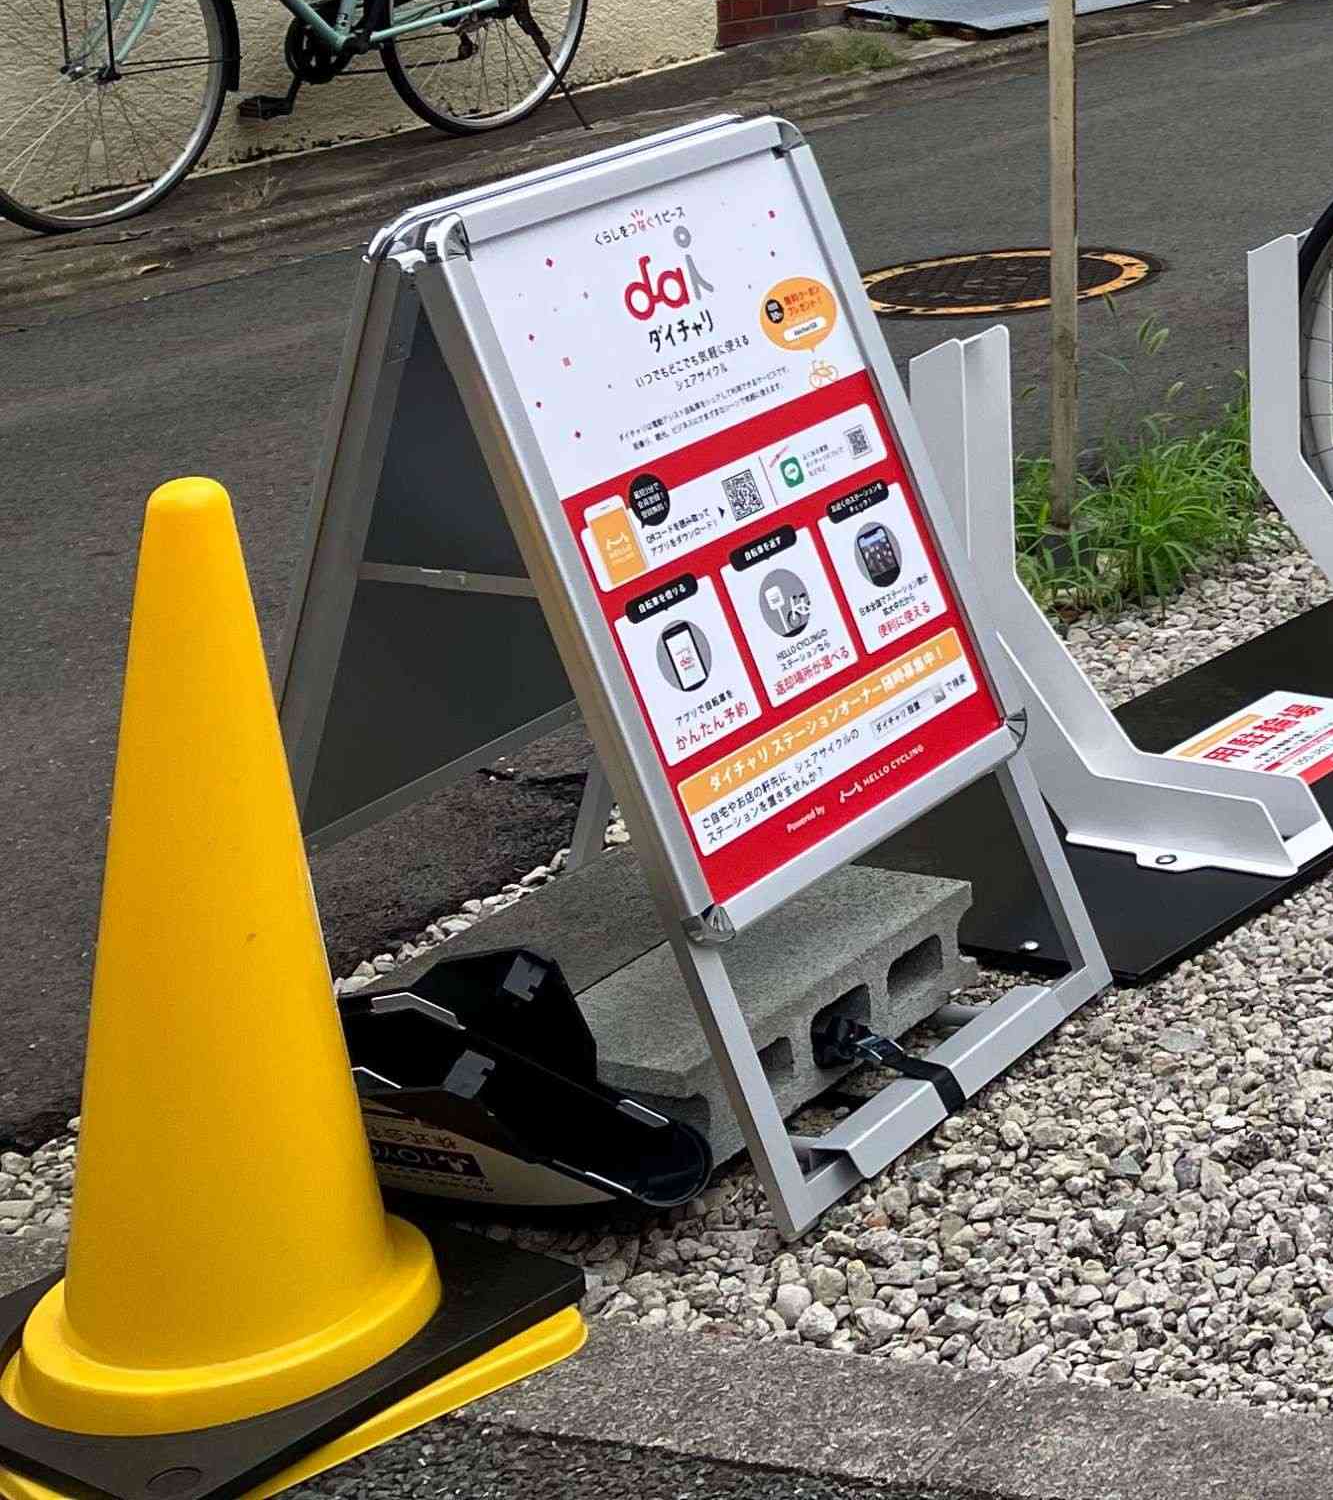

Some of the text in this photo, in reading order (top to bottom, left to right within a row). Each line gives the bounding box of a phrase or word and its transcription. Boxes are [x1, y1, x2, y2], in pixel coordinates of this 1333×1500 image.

[648, 309, 716, 353] ダイチャリ
[877, 600, 930, 638] 便利に使える
[774, 645, 849, 696] 返却場所が選べる
[674, 700, 749, 751] かんたん予約
[863, 743, 924, 786] HELLO CYCLING
